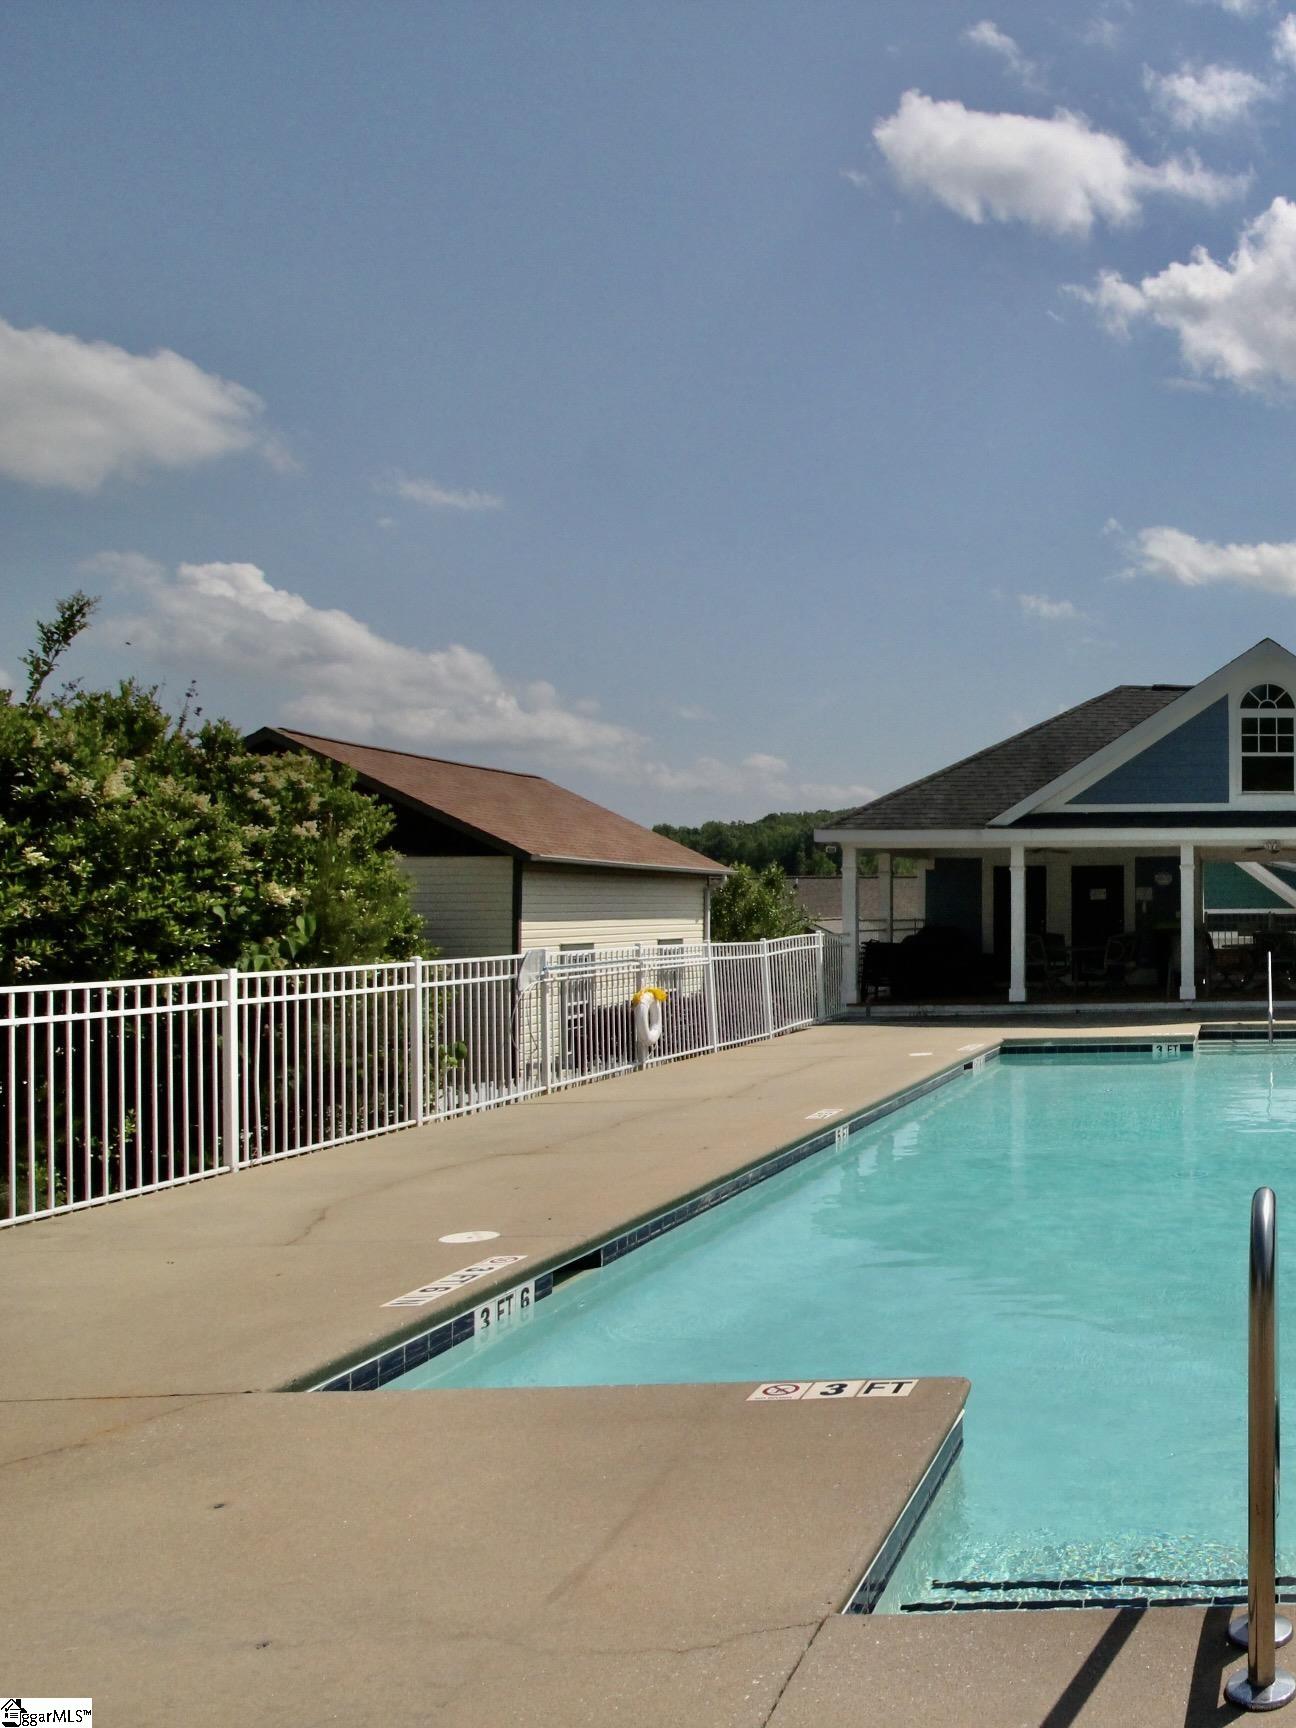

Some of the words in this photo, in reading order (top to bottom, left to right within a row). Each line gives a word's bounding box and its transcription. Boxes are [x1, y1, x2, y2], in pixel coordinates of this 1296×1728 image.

[480, 1307, 491, 1330] 3
[496, 1293, 514, 1321] FT
[520, 1286, 530, 1309] 6
[819, 1382, 848, 1396] 3
[863, 1381, 913, 1395] FT
